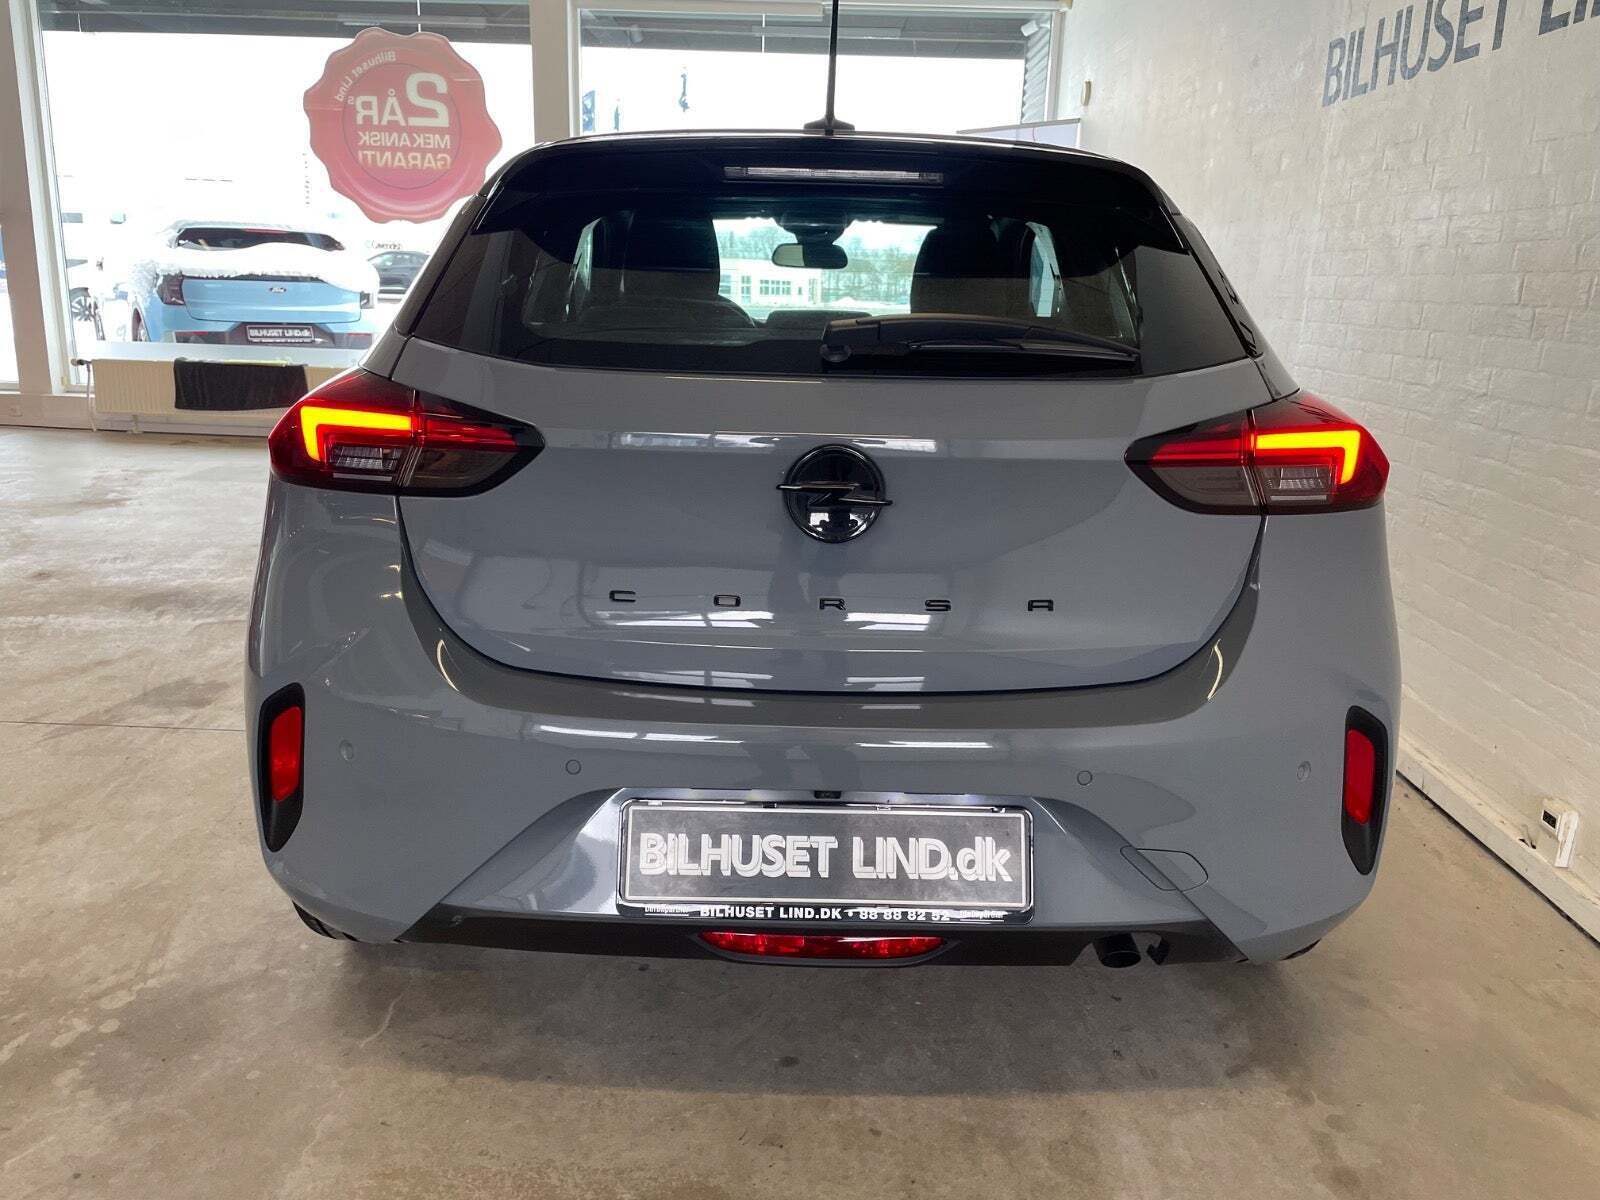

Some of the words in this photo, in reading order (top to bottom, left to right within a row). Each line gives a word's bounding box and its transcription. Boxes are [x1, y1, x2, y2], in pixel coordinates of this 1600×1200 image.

[639, 832, 838, 878] BILHUSET
[852, 836, 1013, 882] LIND.dk
[700, 904, 774, 918] BILHUSET
[780, 906, 842, 919] LIND.DK
